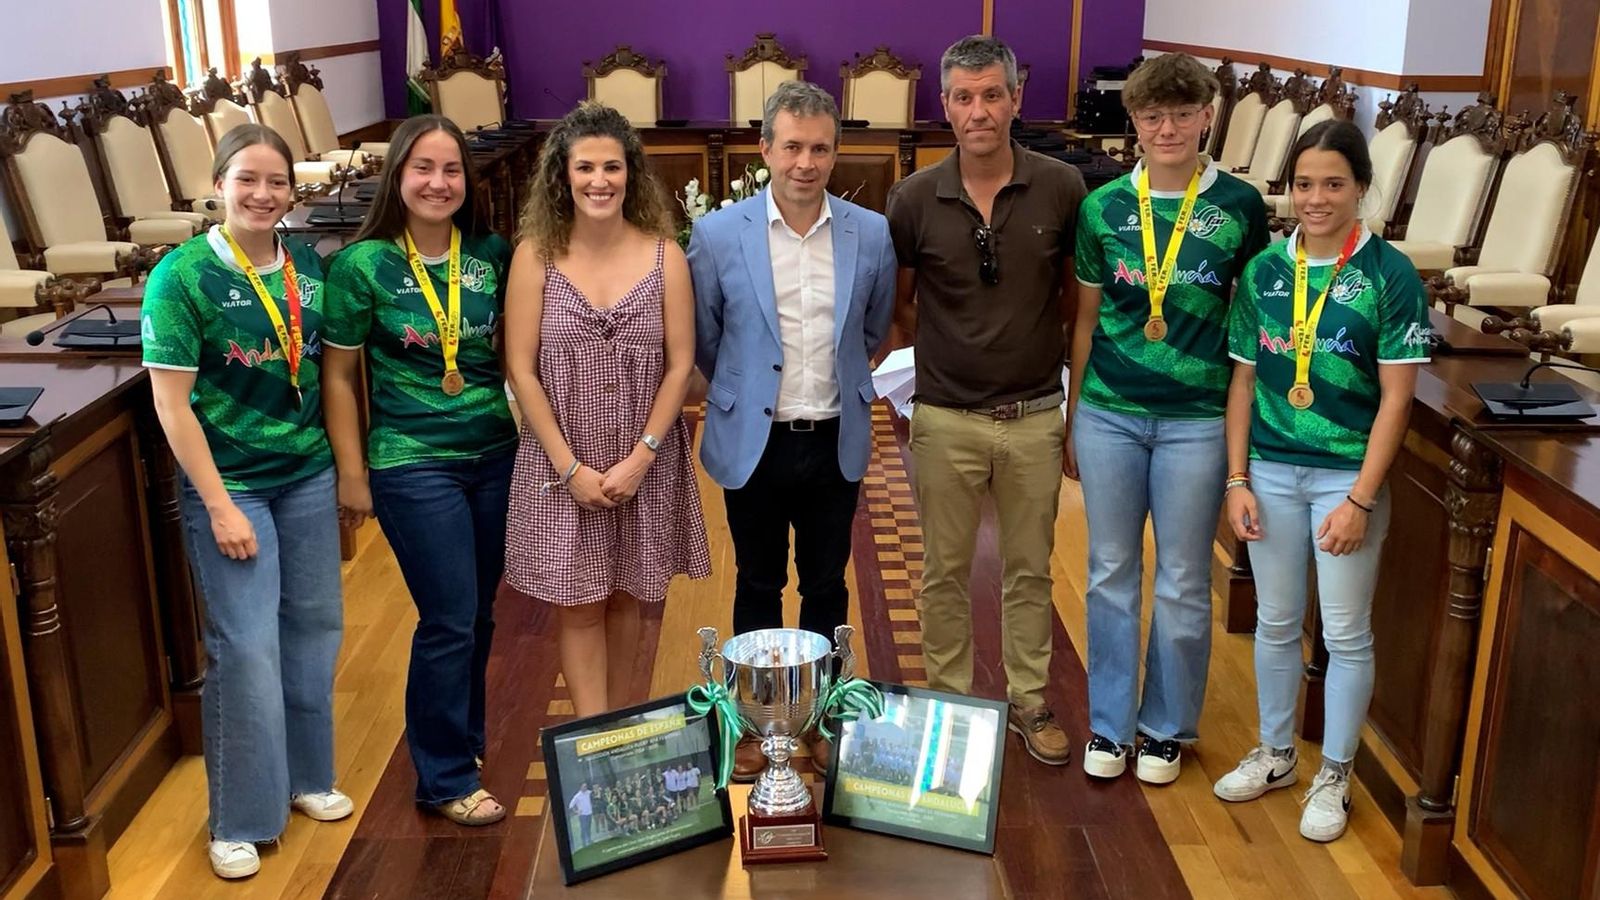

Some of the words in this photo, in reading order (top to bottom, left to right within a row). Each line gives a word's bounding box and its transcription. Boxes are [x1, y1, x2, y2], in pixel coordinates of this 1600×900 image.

[396, 287, 422, 295] VIATO
[222, 299, 252, 308] VIATOR
[581, 731, 635, 751] CAMPEONAS
[637, 727, 647, 736] DE
